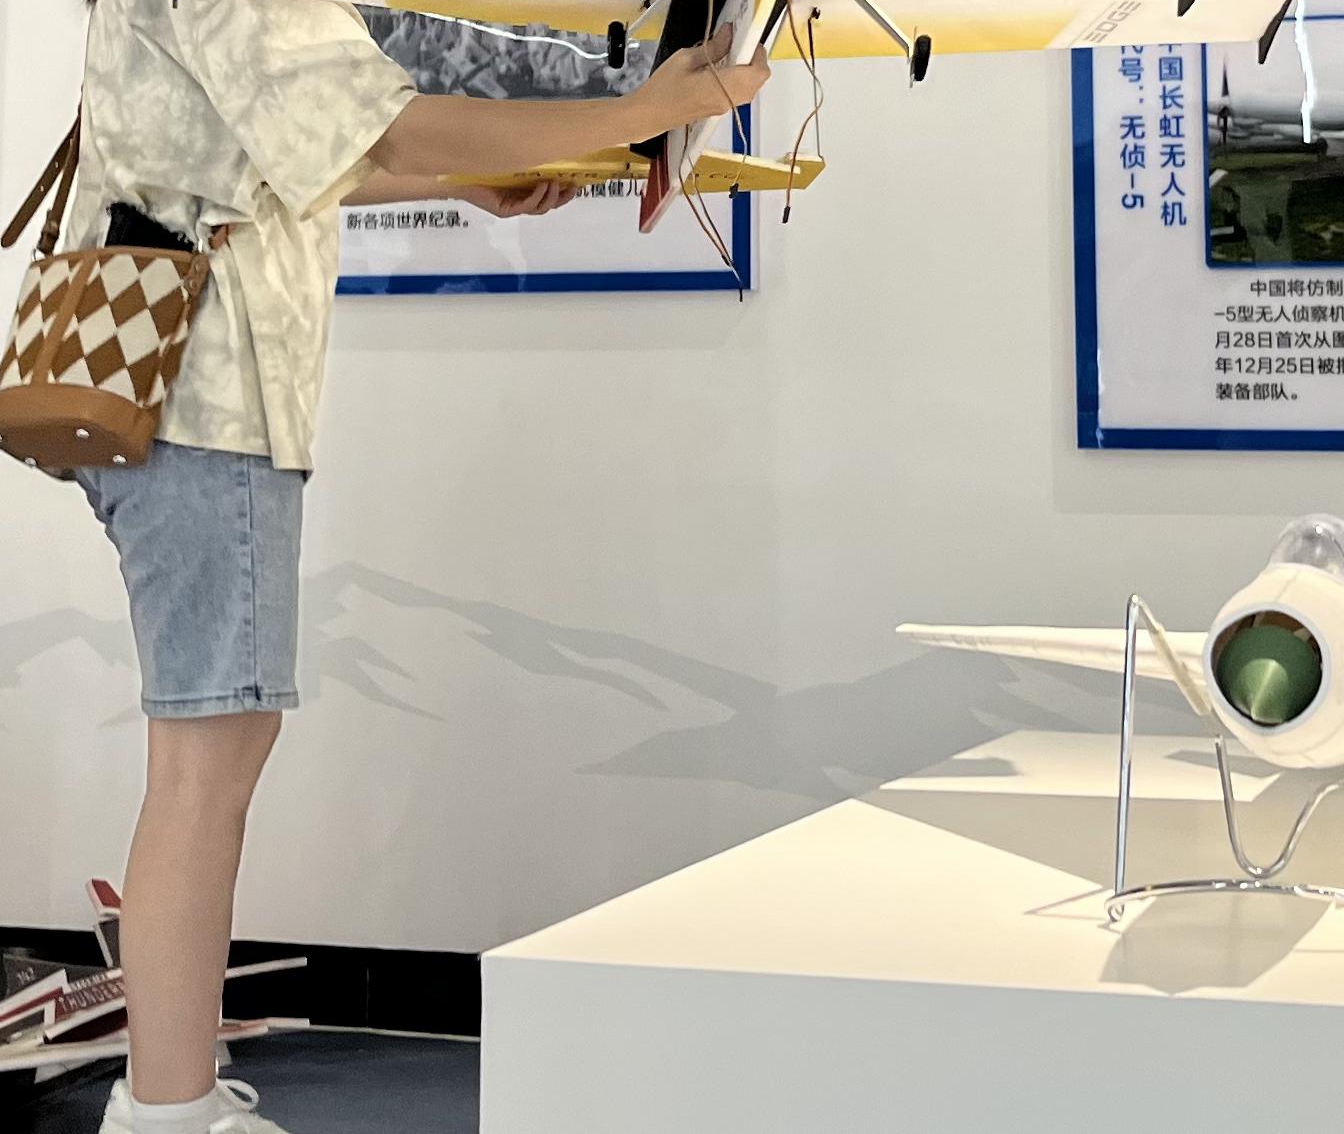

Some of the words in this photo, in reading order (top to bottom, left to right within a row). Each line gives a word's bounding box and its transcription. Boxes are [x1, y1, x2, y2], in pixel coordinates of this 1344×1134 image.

[1118, 46, 1146, 210] 号：无侦-5
[346, 210, 469, 231] 新各项世界纪录。
[1215, 382, 1300, 401] 装备部队。
